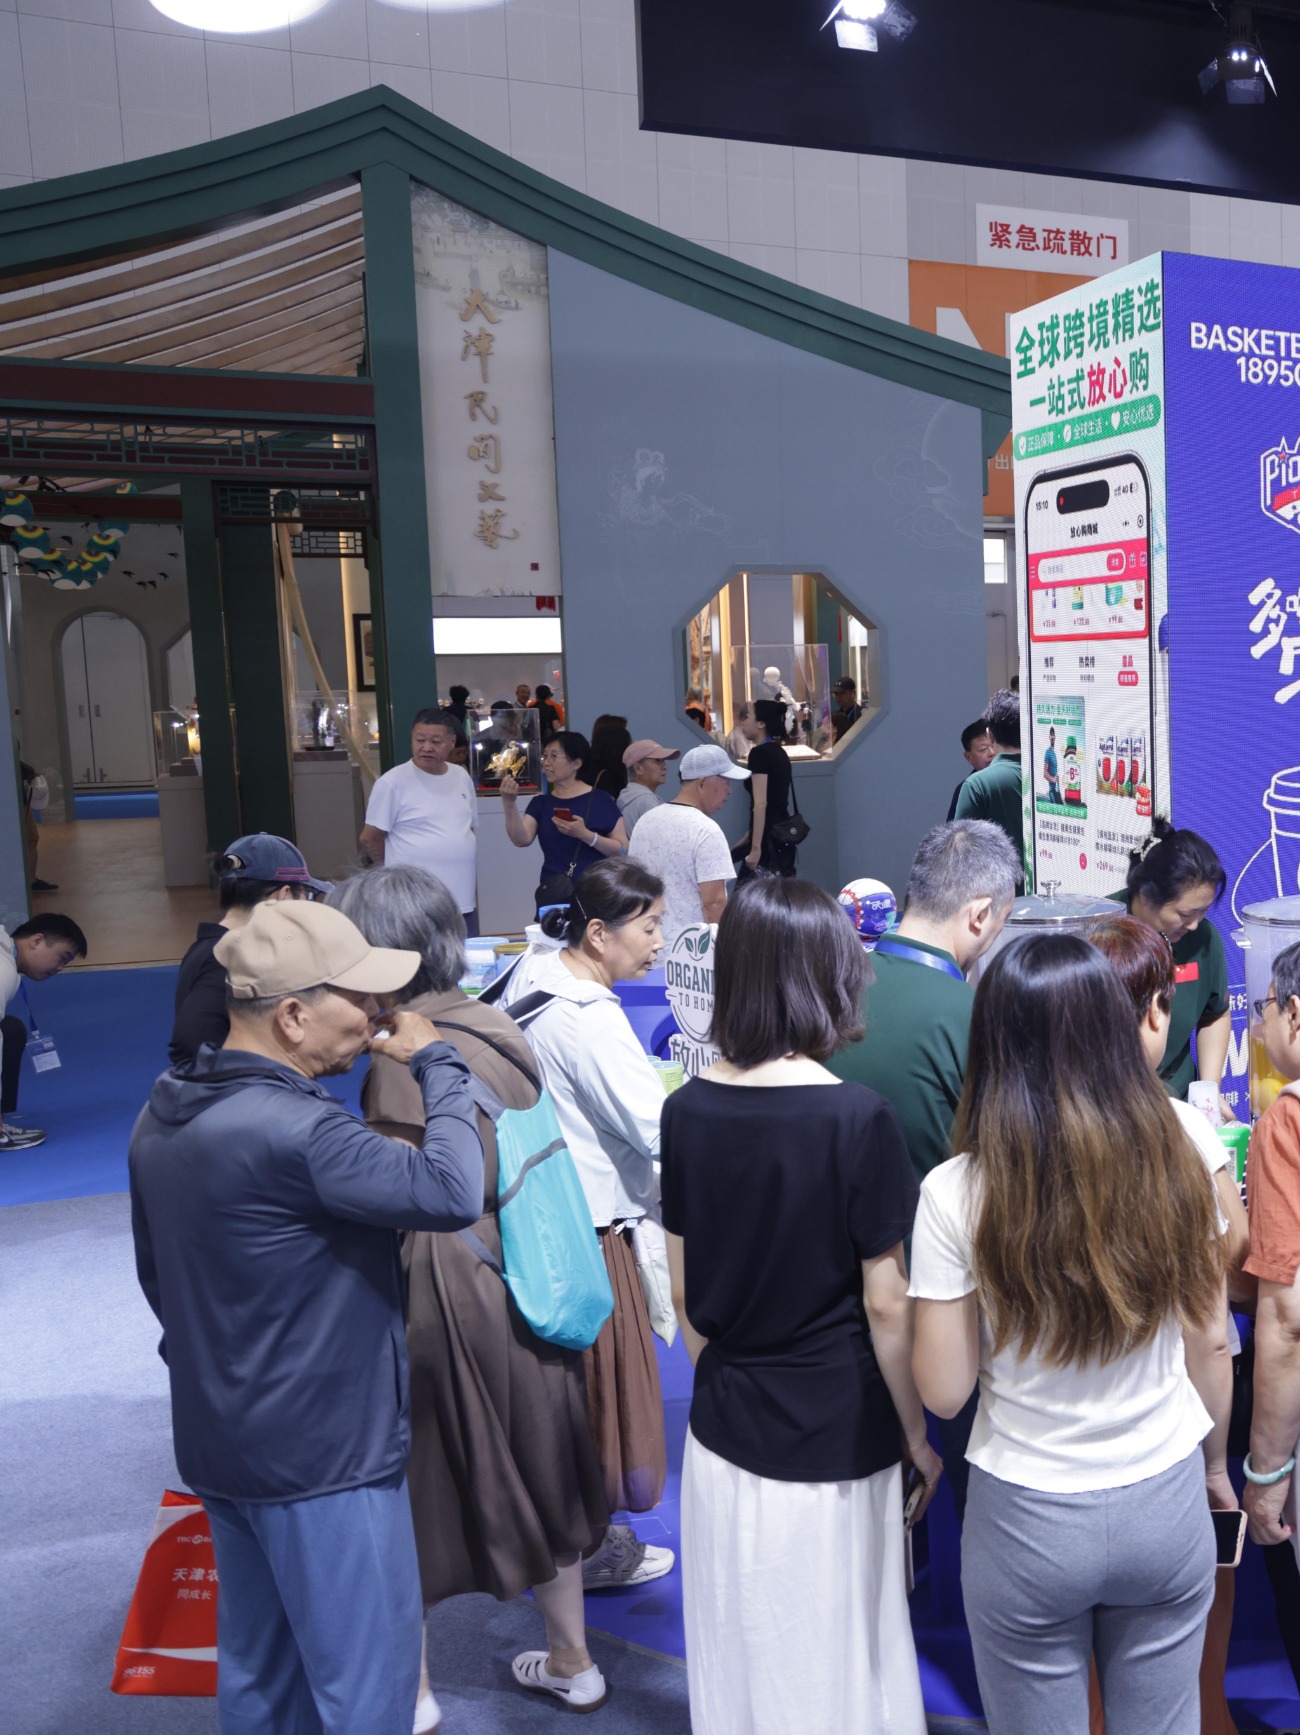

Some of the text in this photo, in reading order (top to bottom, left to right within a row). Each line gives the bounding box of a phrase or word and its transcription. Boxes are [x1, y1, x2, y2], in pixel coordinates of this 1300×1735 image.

[989, 221, 1118, 260] 紧急疏散门
[1015, 278, 1161, 379] 全球跨境精选
[1030, 347, 1149, 417] 一站式放心购
[666, 959, 715, 996] ORGANI
[678, 992, 714, 1013] TO HOM
